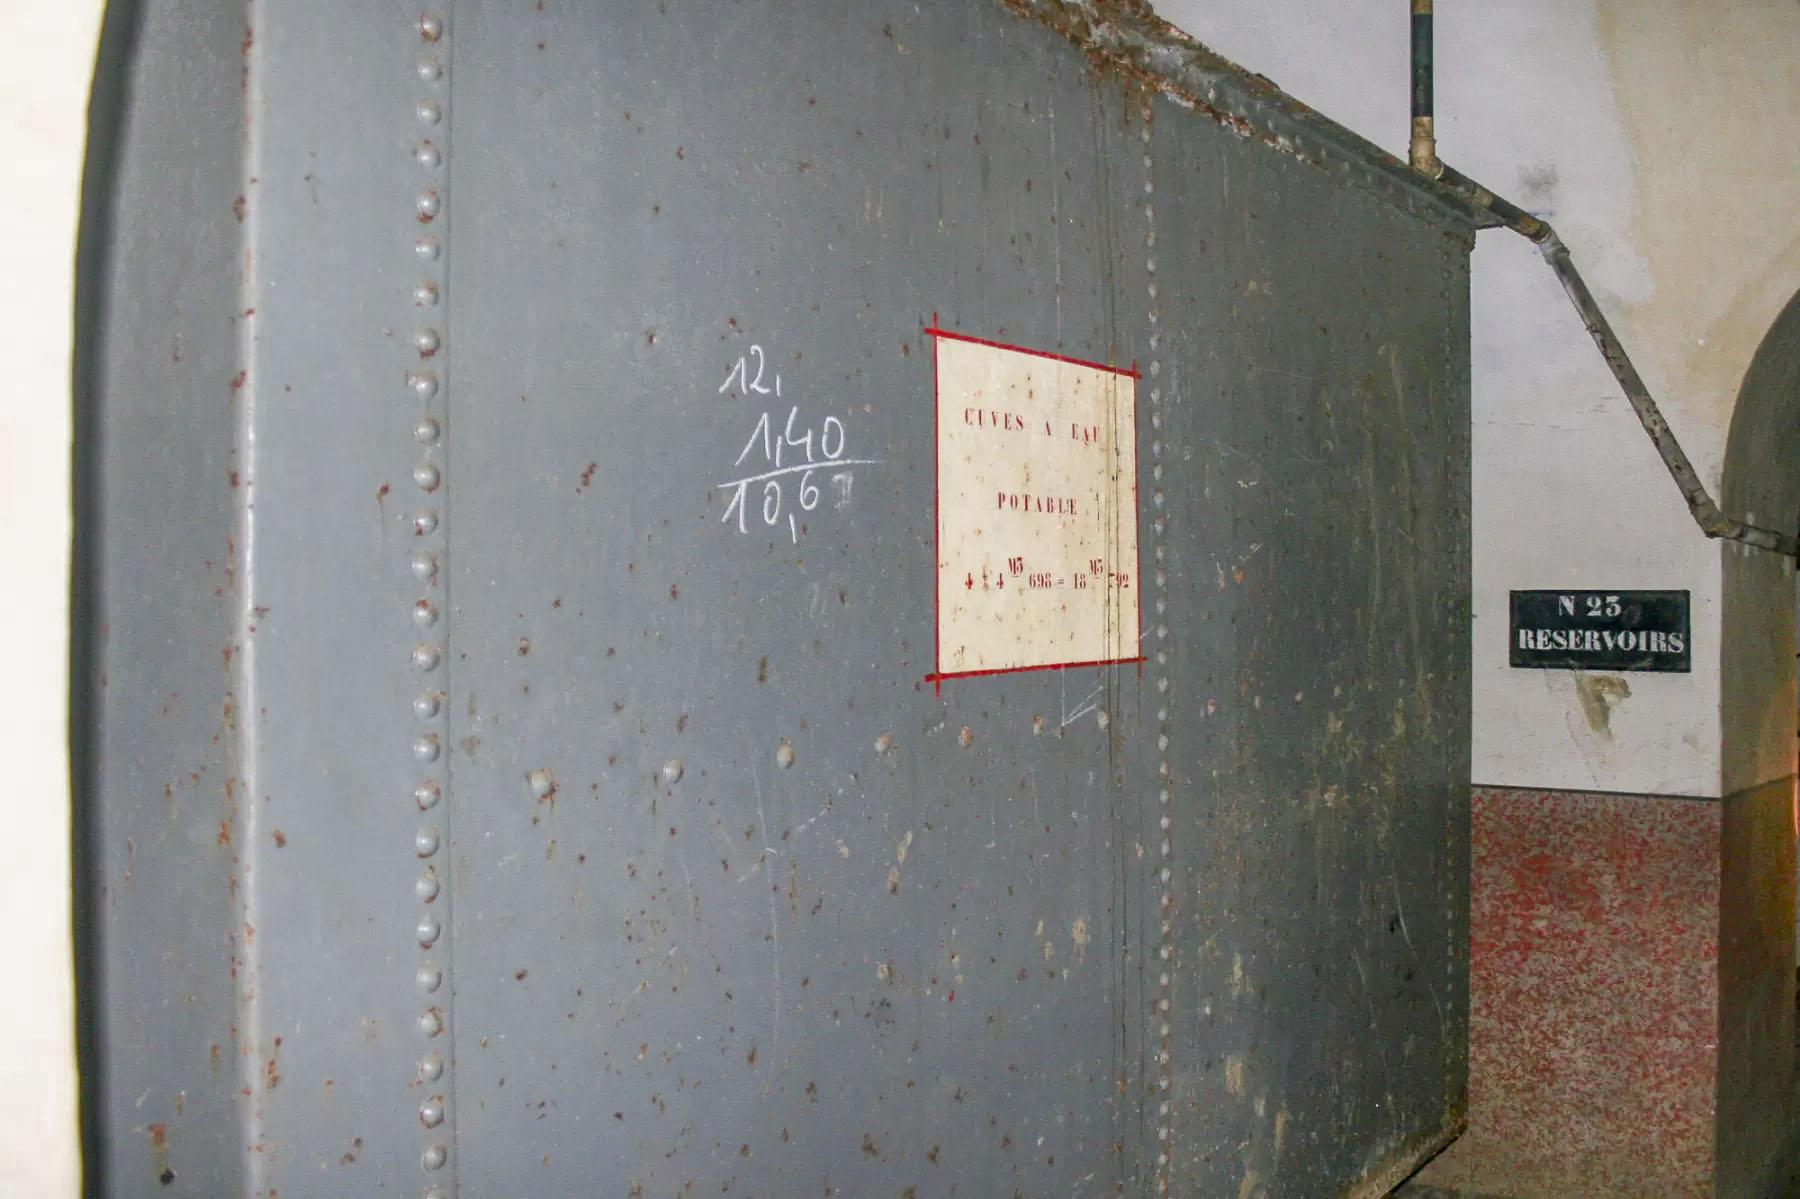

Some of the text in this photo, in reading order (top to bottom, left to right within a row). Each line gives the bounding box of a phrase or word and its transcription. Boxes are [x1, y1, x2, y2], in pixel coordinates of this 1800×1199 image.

[734, 405, 845, 468] 1,40
[964, 407, 1024, 432] CUVES
[1071, 422, 1100, 443] EAU
[997, 491, 1077, 515] POTABLE
[1028, 572, 1052, 590] 698
[1586, 595, 1622, 617] 25
[1518, 628, 1685, 653] RESERVOIRS
